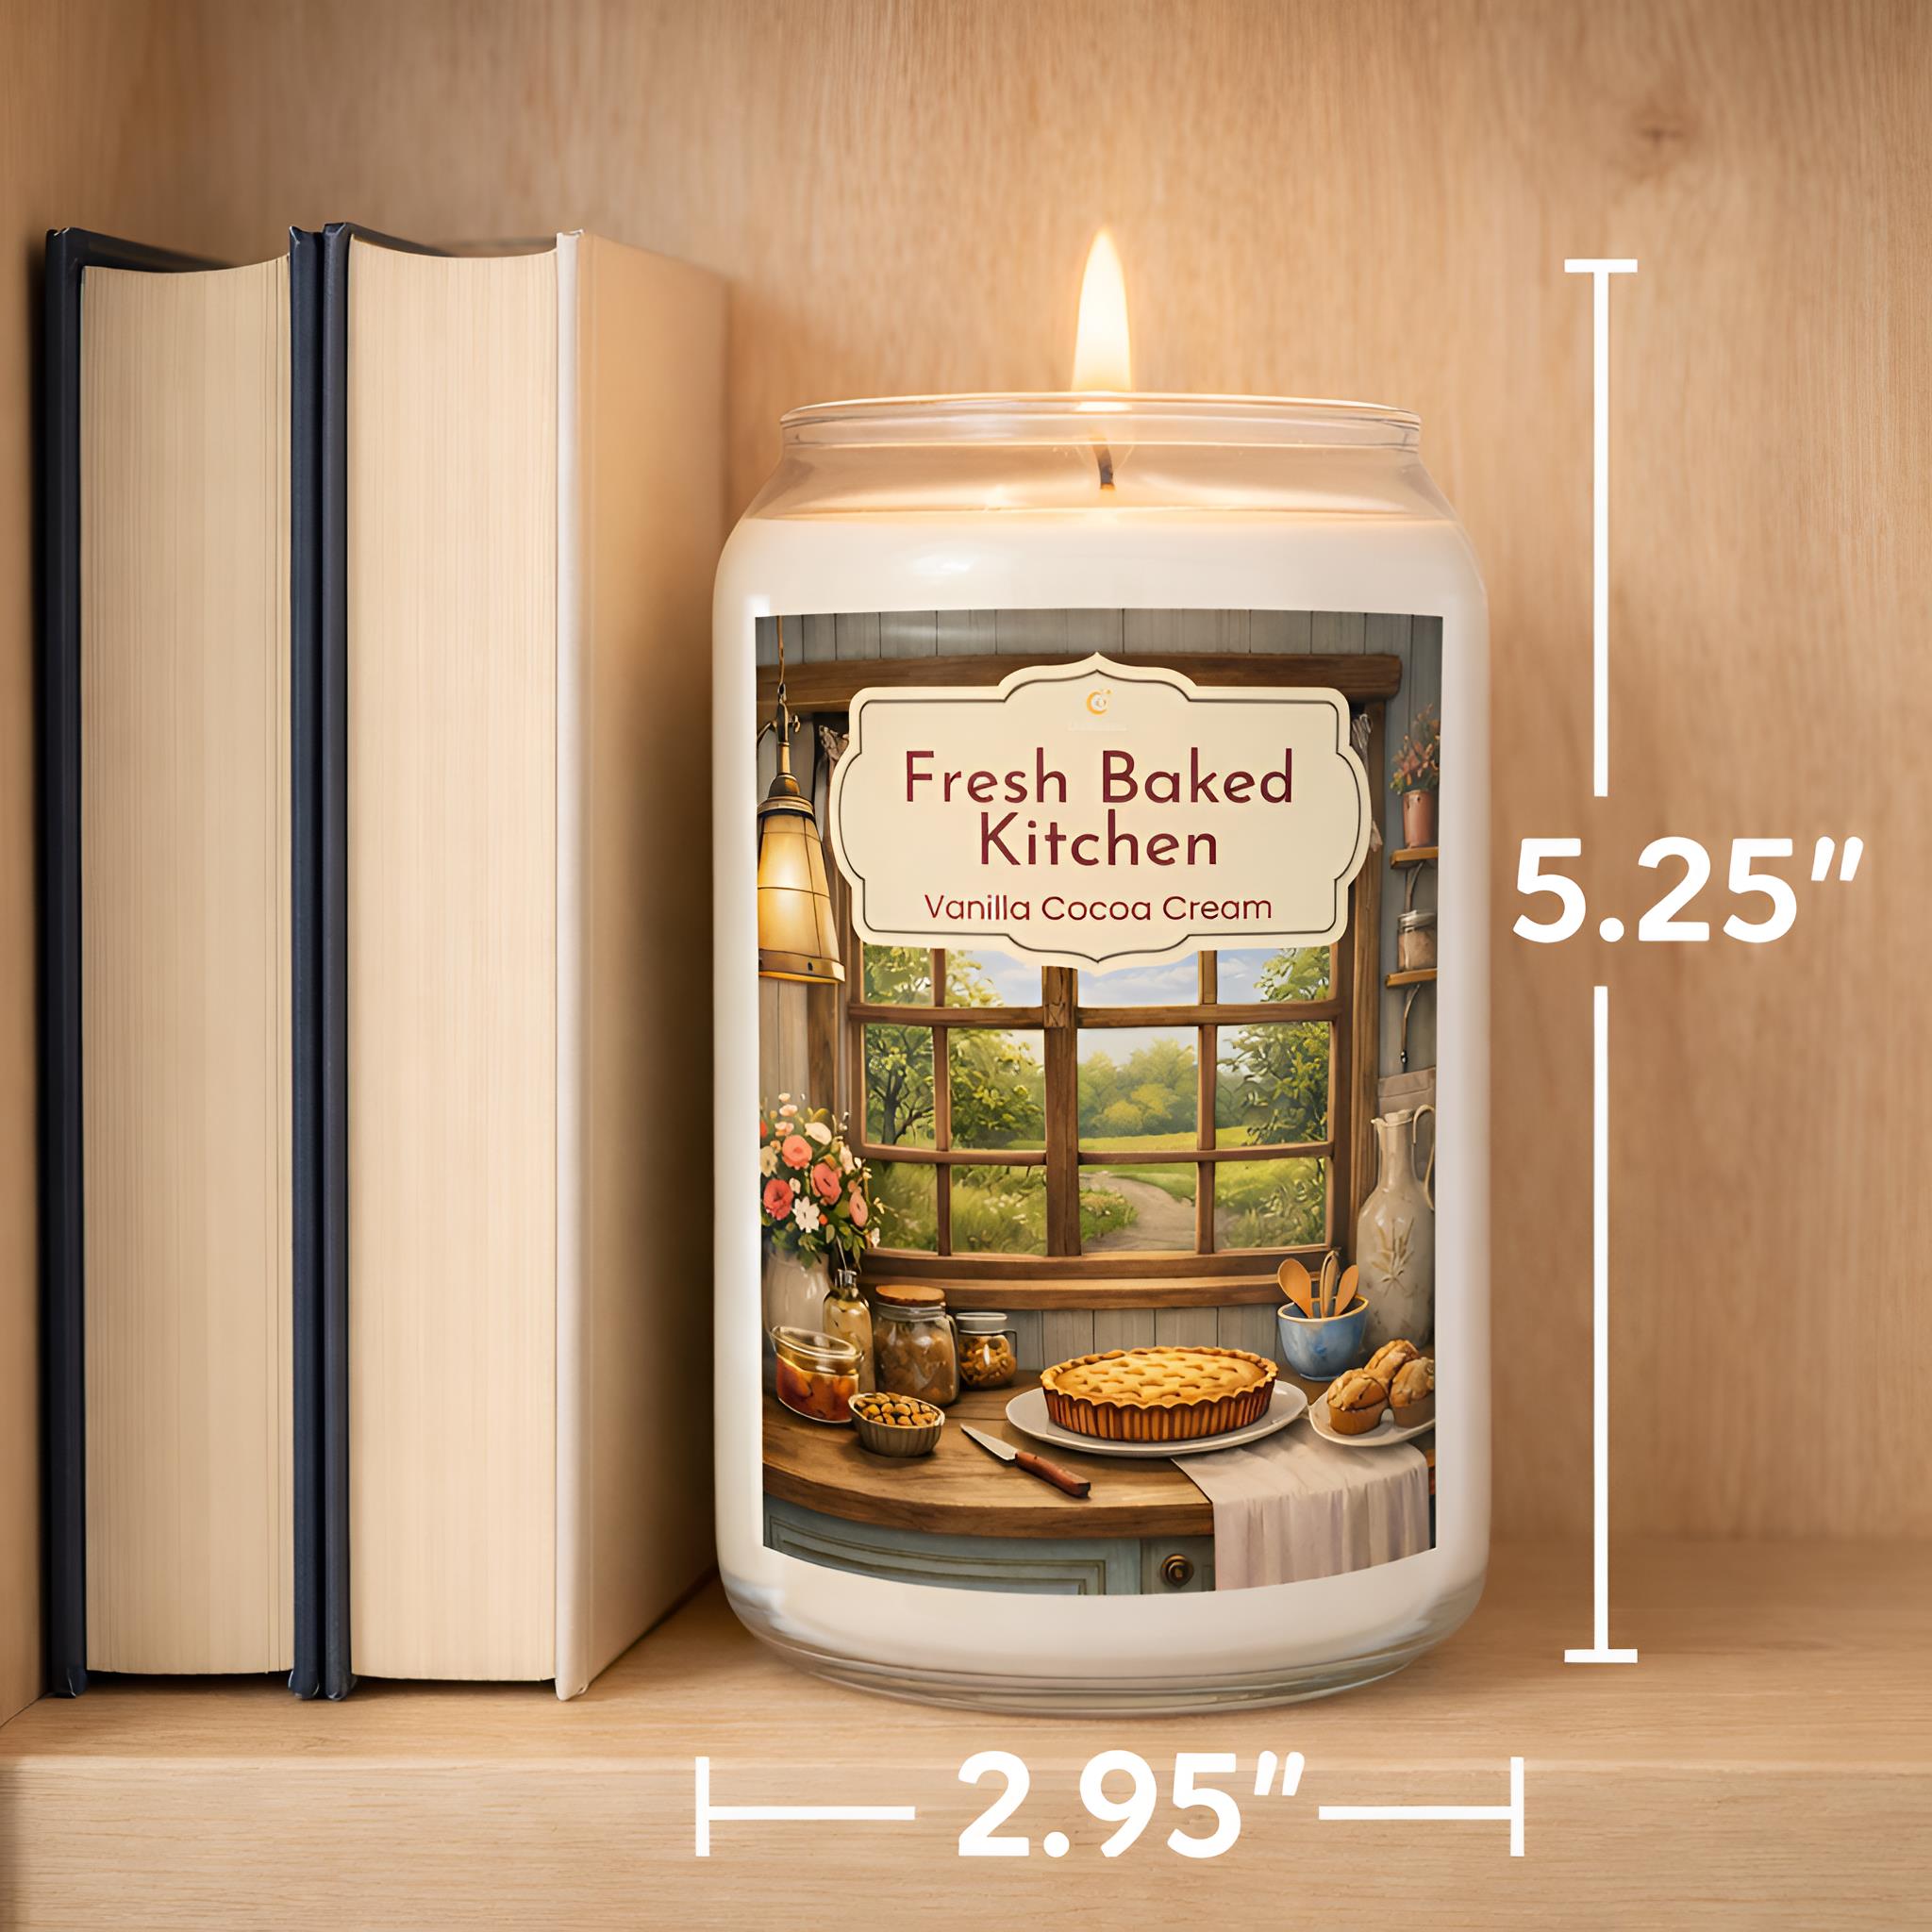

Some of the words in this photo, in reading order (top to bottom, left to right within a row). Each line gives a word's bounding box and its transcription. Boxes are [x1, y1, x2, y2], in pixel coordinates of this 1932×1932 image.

[907, 747, 1066, 803] Fresh
[1103, 747, 1291, 803] Baked
[981, 809, 1216, 866] Kitchen
[924, 894, 1029, 920] Vanilla
[1041, 896, 1150, 921] Cocoa
[1163, 896, 1271, 920] Cream
